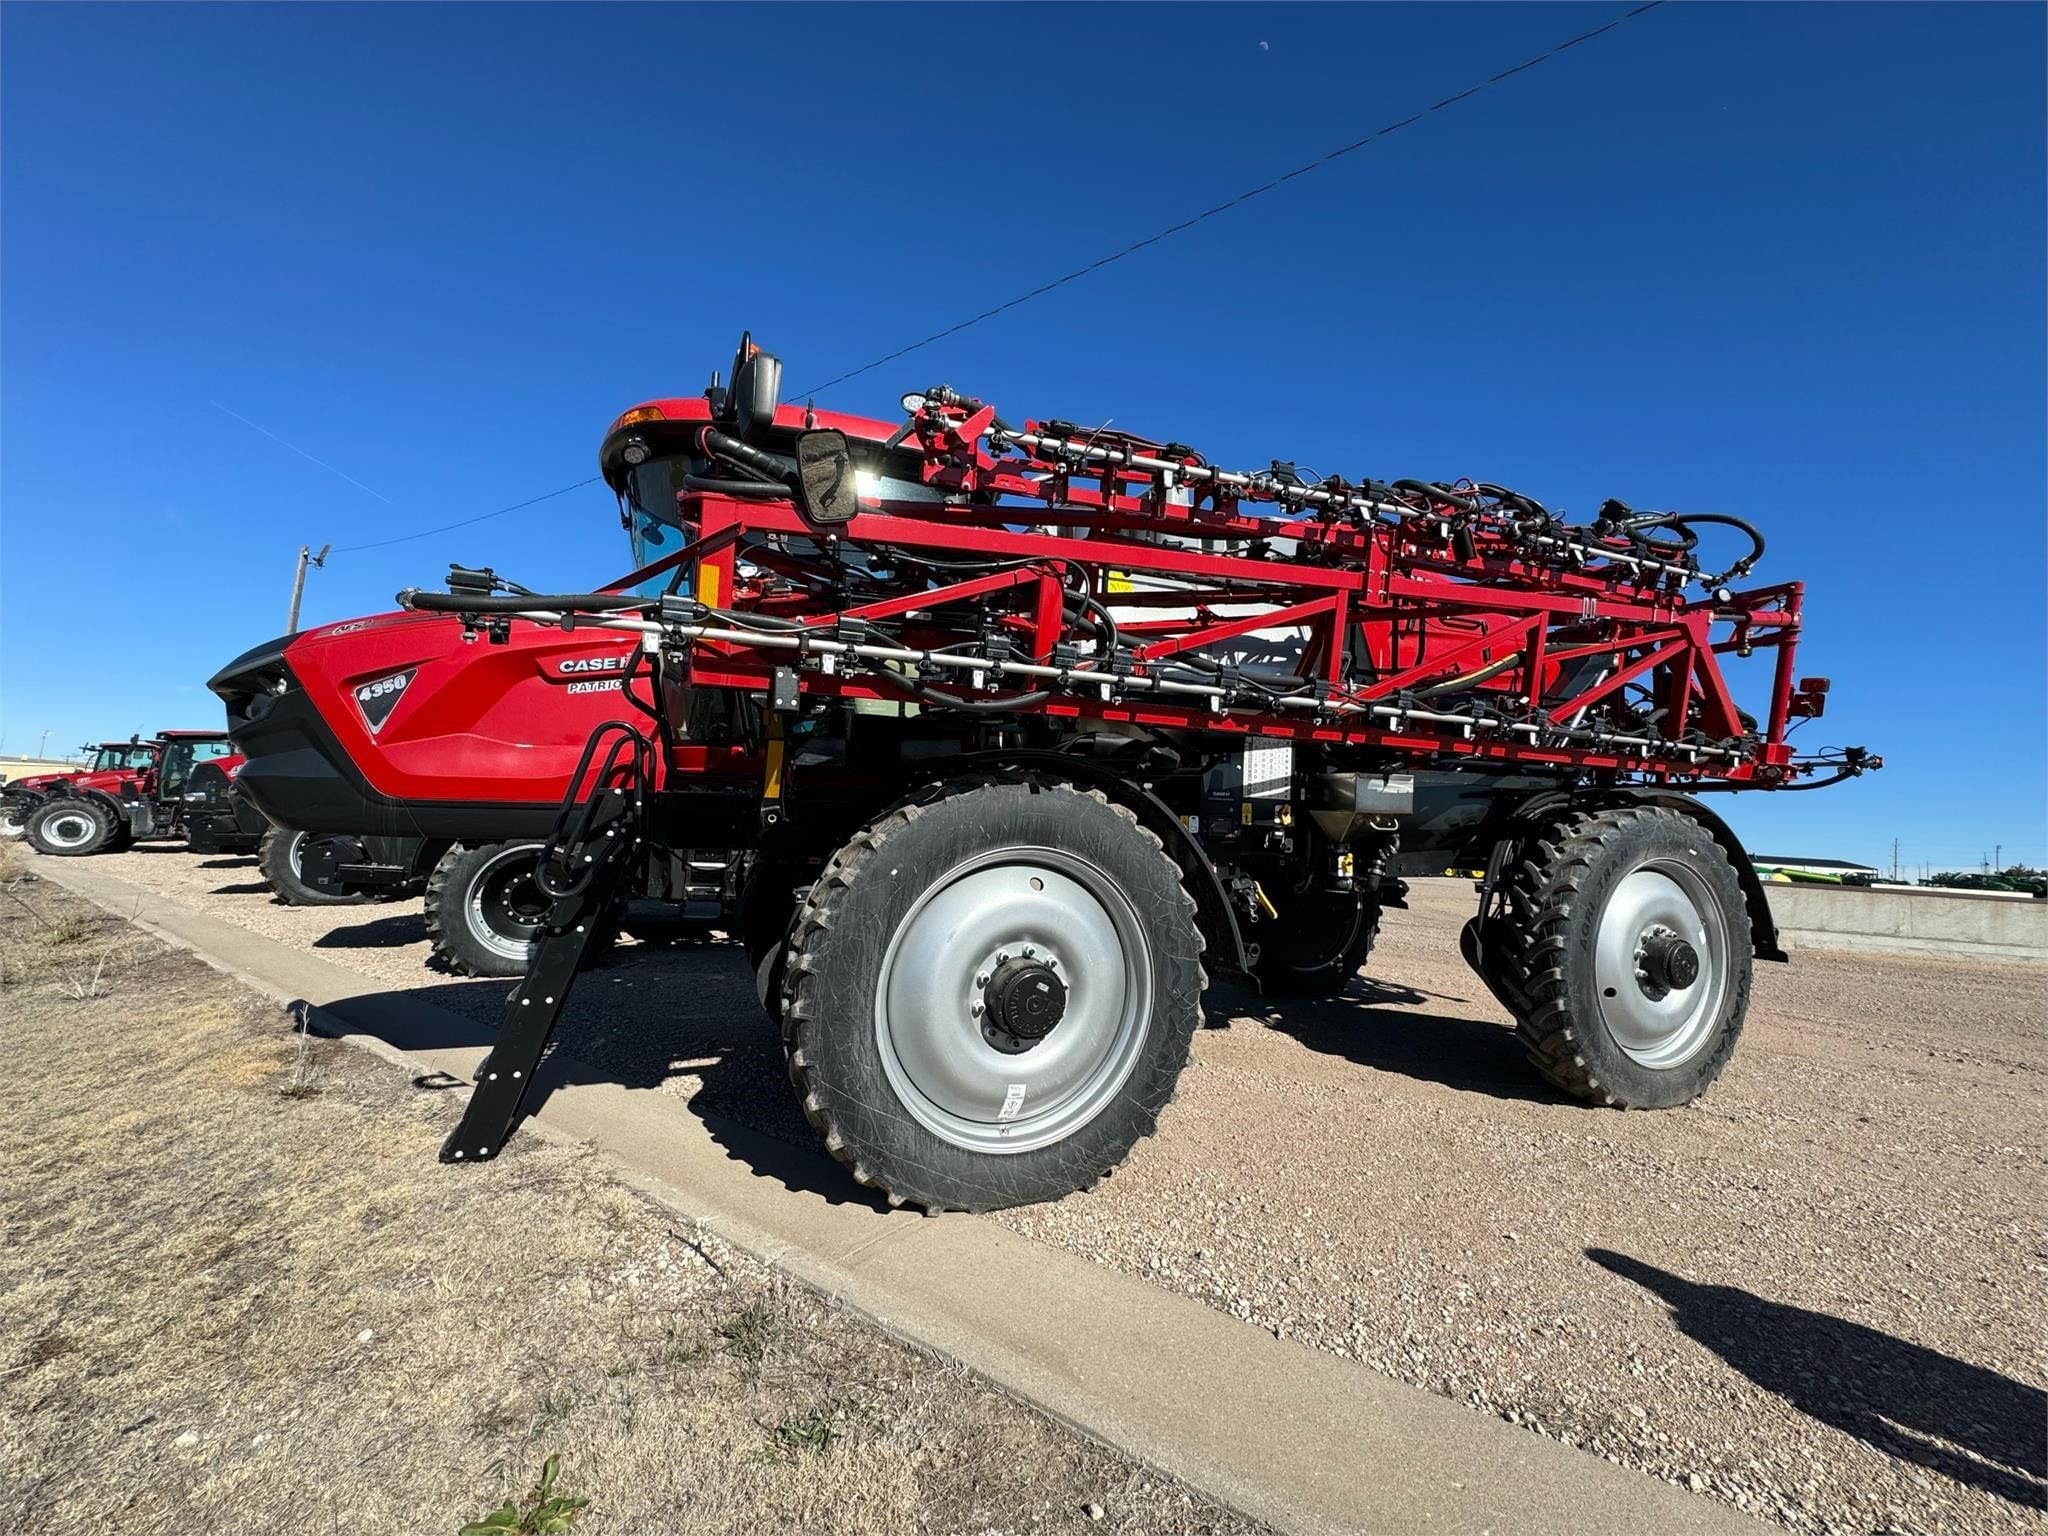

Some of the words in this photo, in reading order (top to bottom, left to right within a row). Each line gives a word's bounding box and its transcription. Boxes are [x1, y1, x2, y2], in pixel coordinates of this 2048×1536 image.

[559, 658, 616, 673] CASE
[358, 674, 407, 702] 4350
[568, 679, 631, 694] PATRIO
